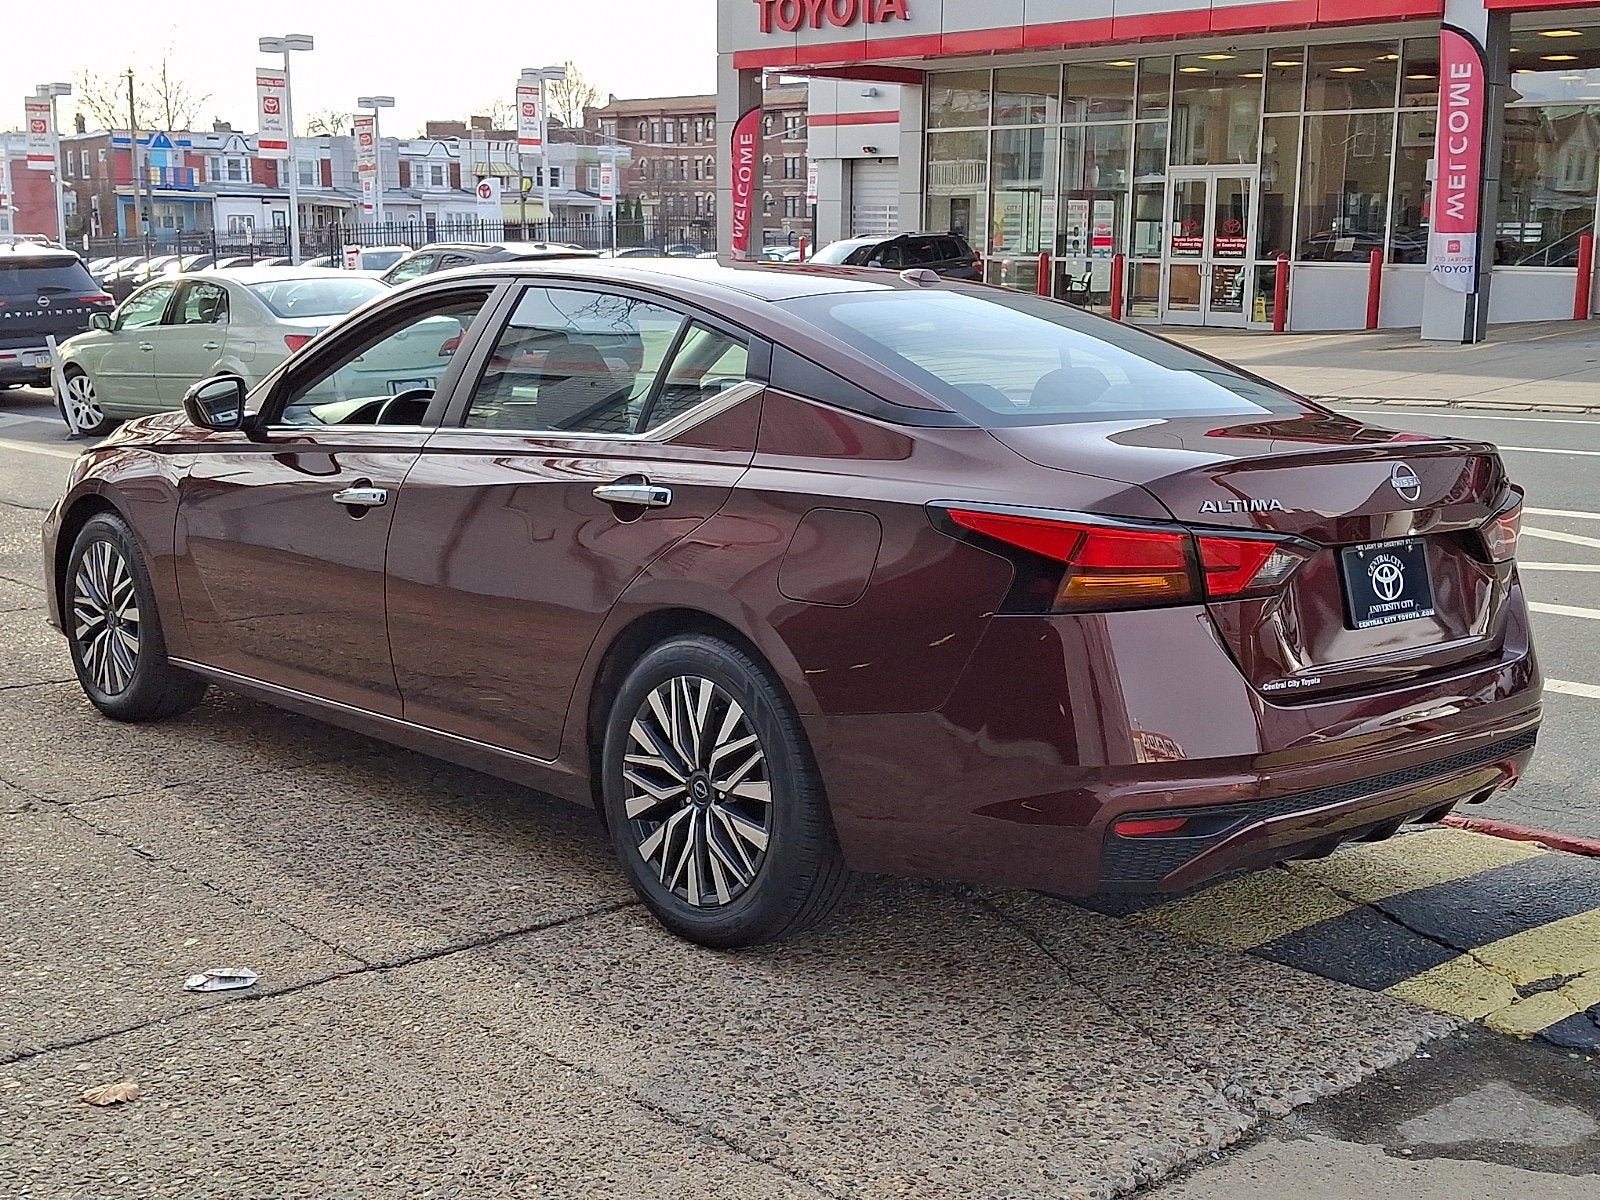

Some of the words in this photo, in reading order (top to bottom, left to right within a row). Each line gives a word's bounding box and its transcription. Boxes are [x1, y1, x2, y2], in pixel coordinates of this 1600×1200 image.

[753, 0, 910, 33] TOYOTA
[732, 134, 753, 239] WELCOME
[0, 307, 92, 319] ATHFINDER
[1199, 498, 1284, 513] ALTIMA
[1367, 553, 1391, 577] CENTRAL
[1390, 555, 1406, 572] CITY
[1369, 601, 1400, 613] UNIVERSITY
[1400, 599, 1414, 608] CITY
[1358, 619, 1384, 628] CENTRAL
[1263, 680, 1287, 691] Central
[1287, 679, 1300, 688] City
[1300, 677, 1321, 687] Toyota
